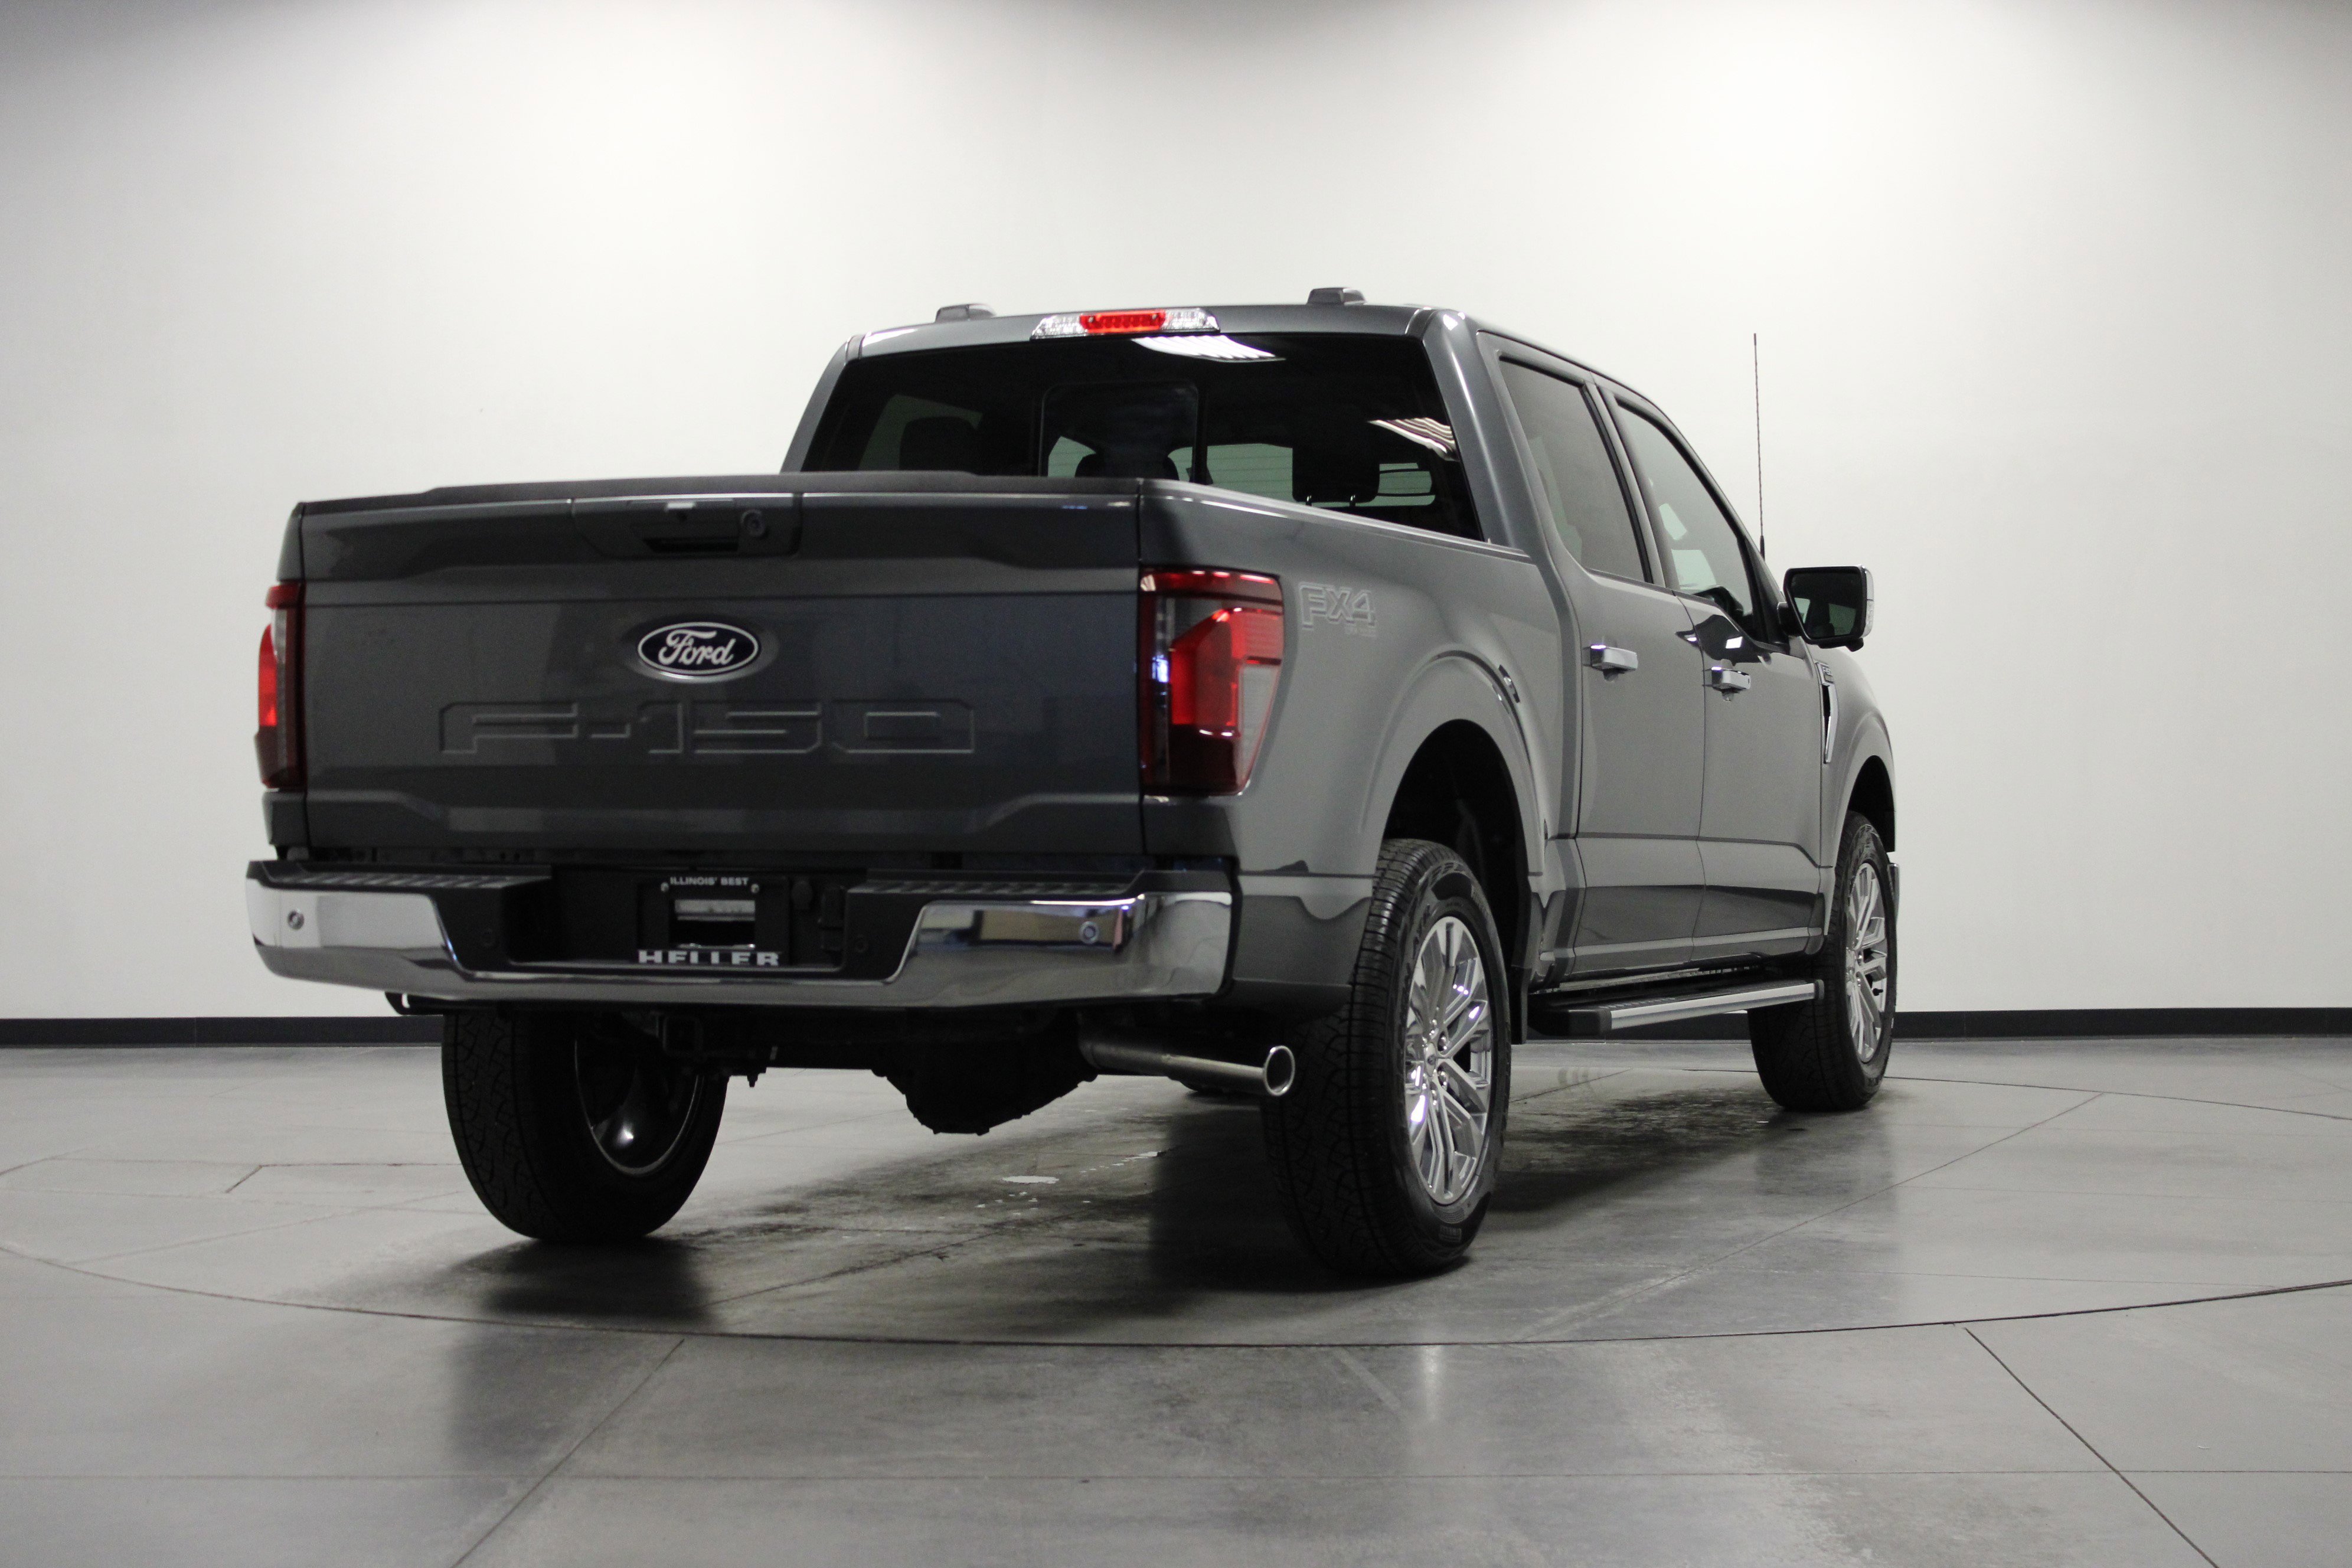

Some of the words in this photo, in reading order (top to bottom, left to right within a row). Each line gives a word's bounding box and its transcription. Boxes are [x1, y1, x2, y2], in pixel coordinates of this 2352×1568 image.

[1298, 581, 1376, 630] FX4
[658, 628, 736, 667] Ford
[439, 700, 976, 755] F-150
[720, 877, 750, 886] BEST
